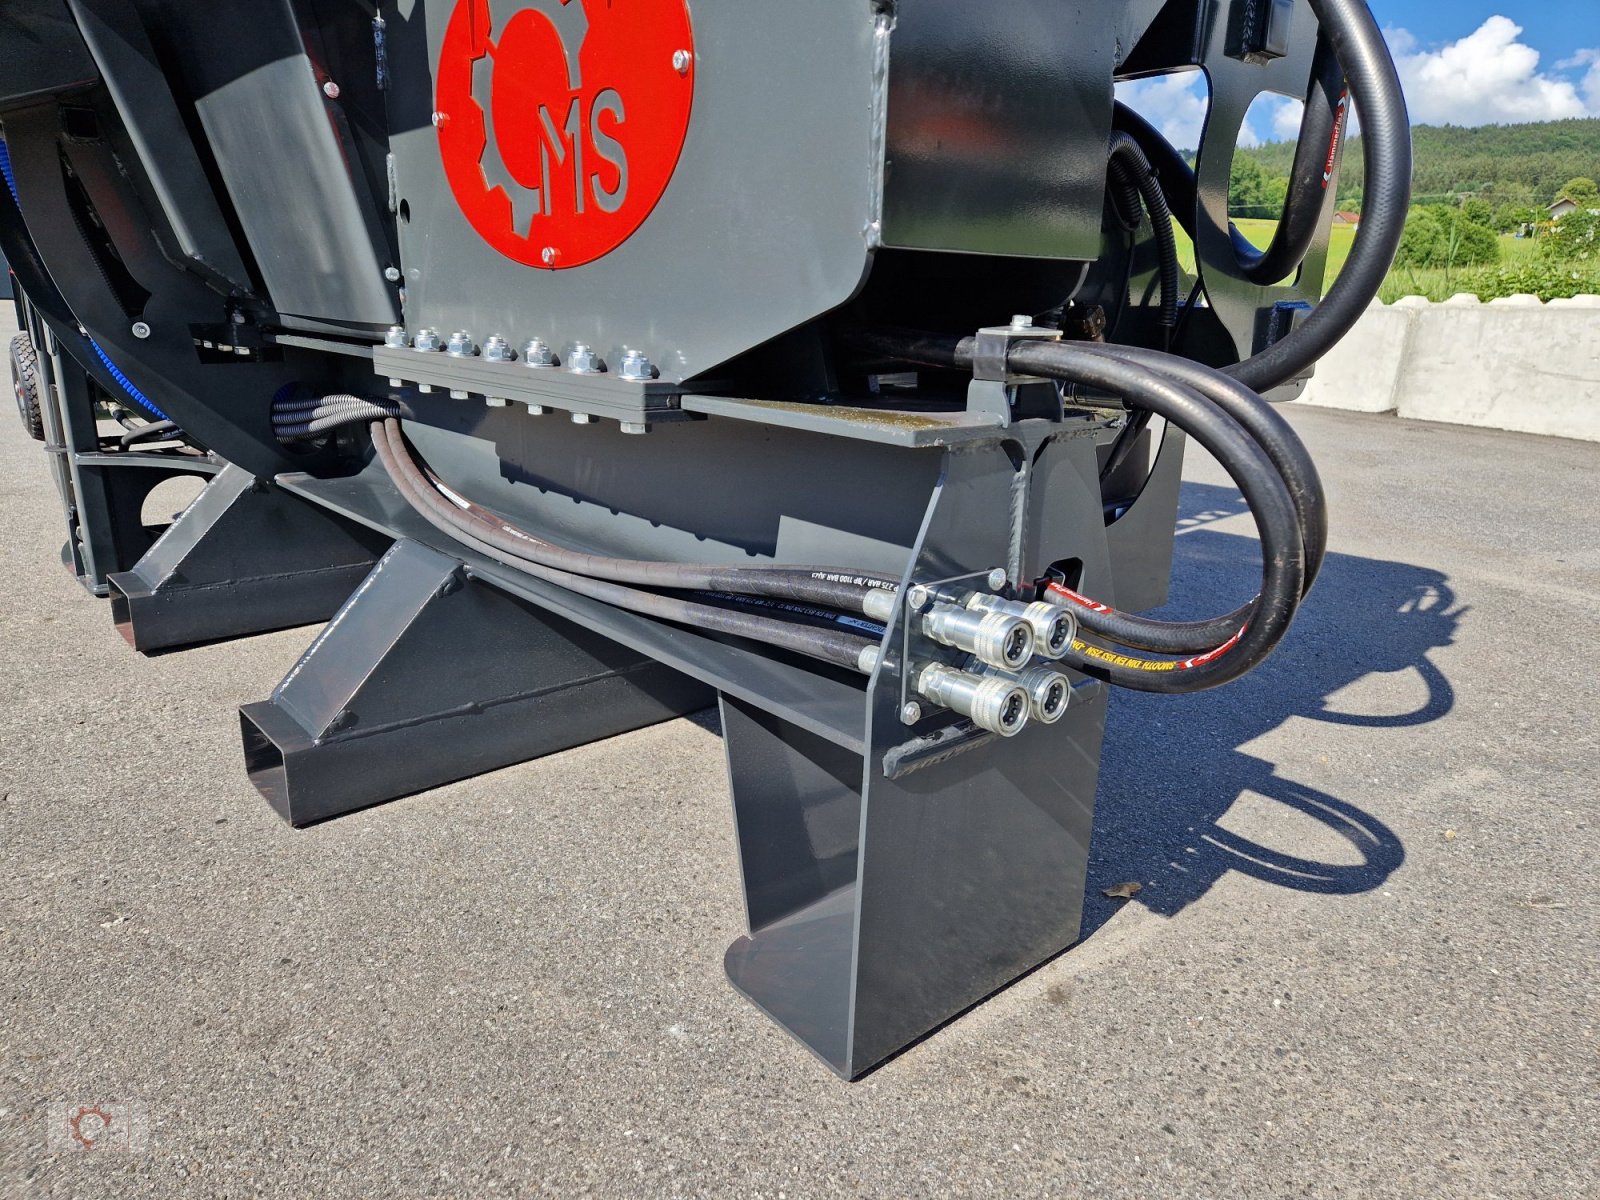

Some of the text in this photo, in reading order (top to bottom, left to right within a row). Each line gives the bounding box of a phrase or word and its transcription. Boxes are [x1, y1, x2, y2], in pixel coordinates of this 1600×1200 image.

[1327, 112, 1343, 167] HammerFlex
[538, 87, 629, 216] MS
[826, 573, 840, 582] BAR
[839, 575, 853, 584] 1100
[853, 577, 863, 586] BP
[867, 579, 882, 588] BAR
[881, 581, 892, 591] 275
[1085, 646, 1105, 658] 2SN
[1101, 652, 1115, 663] 853
[1114, 656, 1127, 667] EN
[1126, 659, 1142, 669] DIN
[1142, 661, 1176, 670] SMOOTH
